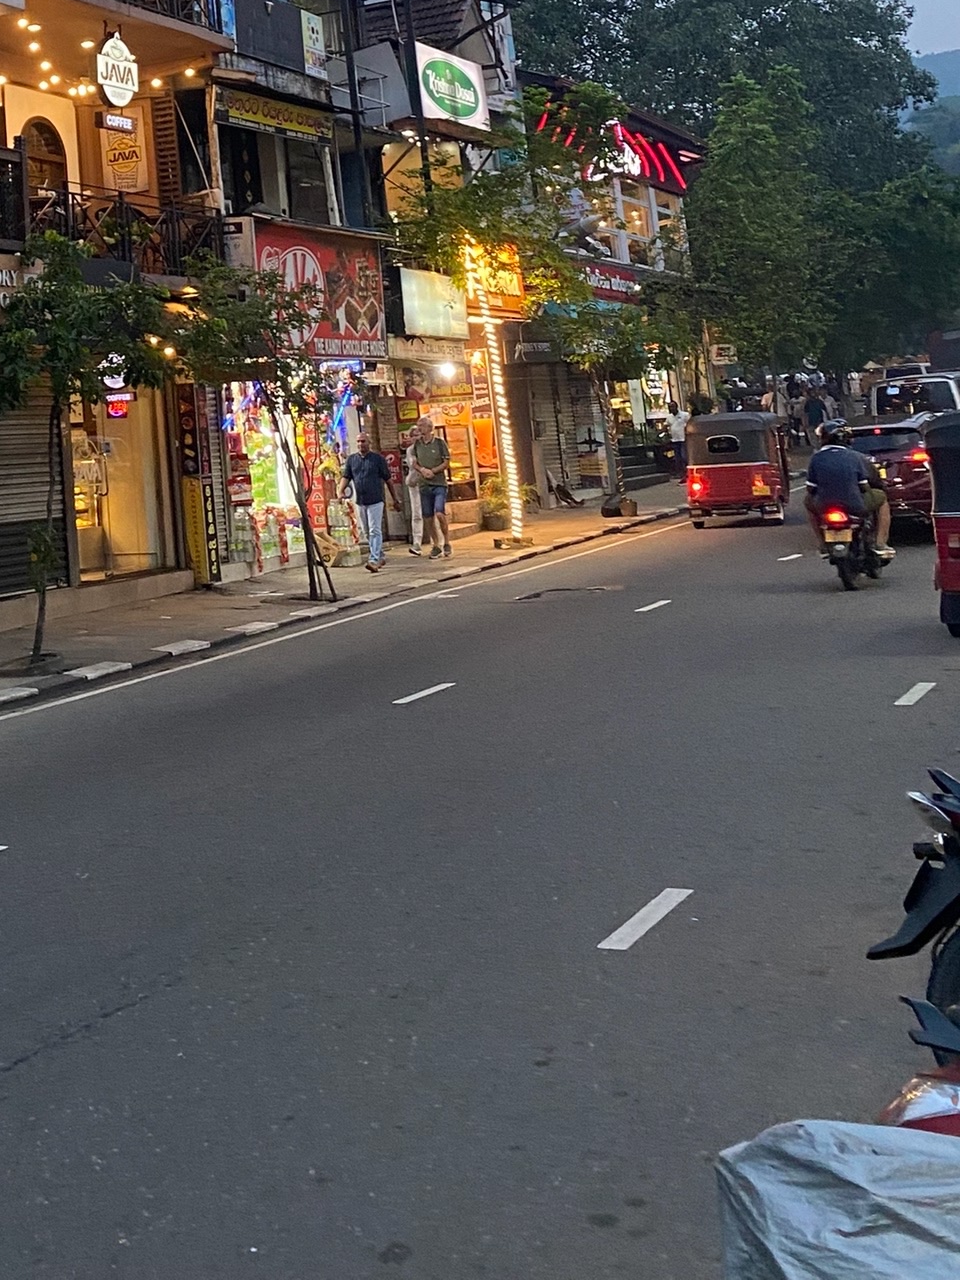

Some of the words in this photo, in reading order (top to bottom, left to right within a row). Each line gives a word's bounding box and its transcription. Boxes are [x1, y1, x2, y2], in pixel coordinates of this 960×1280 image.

[100, 61, 135, 86] JAVA
[106, 114, 133, 130] COFFEE
[109, 150, 139, 163] JAVA
